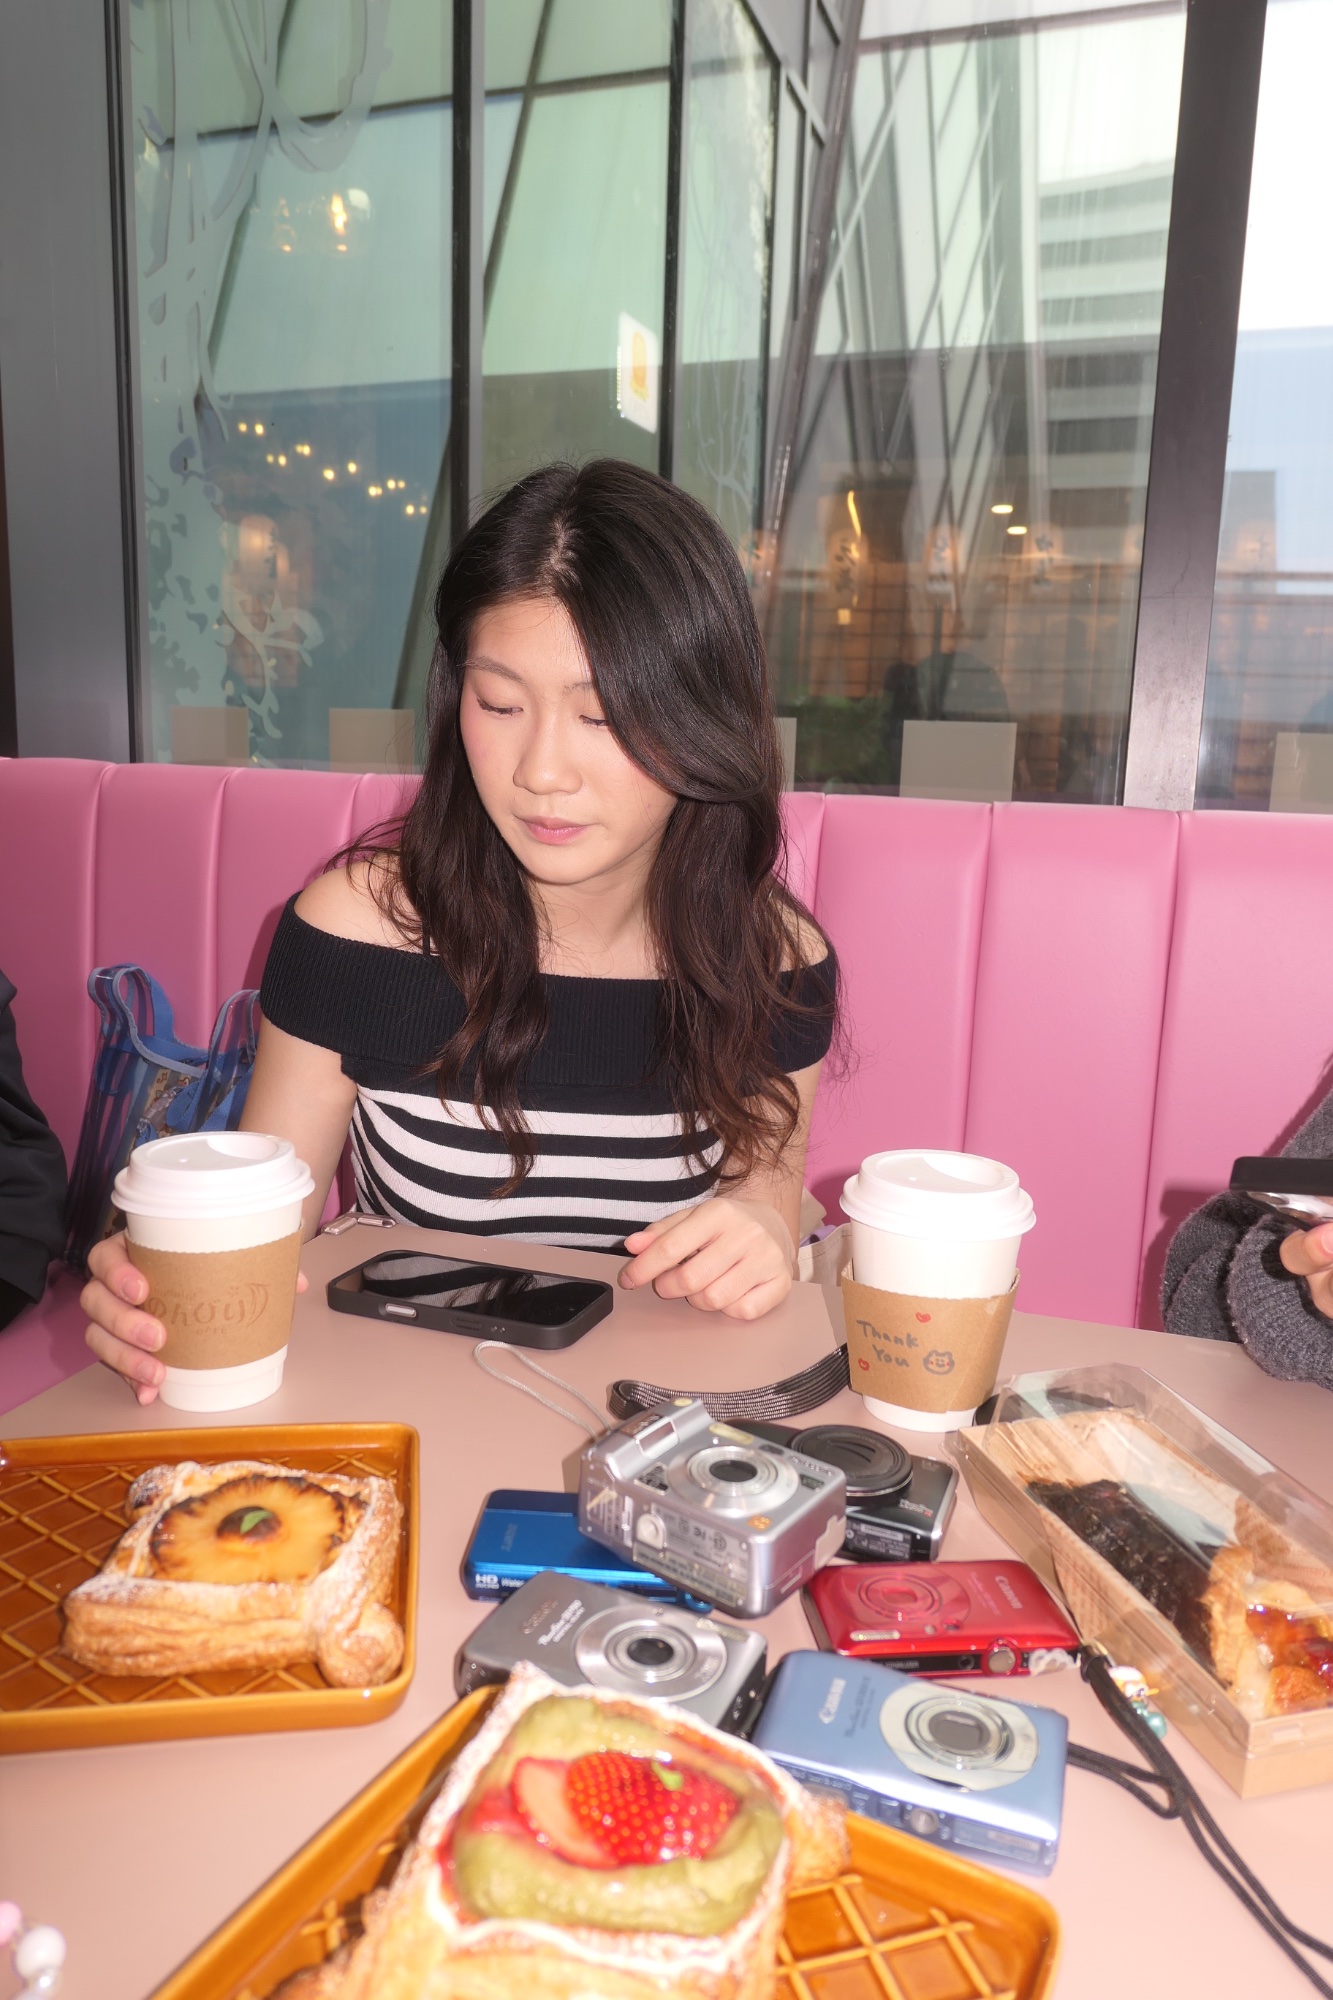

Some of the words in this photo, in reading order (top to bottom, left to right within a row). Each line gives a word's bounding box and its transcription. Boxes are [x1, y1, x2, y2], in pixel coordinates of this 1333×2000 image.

[856, 1319, 919, 1348] Thank
[872, 1344, 910, 1368] You
[995, 1576, 1023, 1609] Canon
[819, 1678, 846, 1724] Canon
